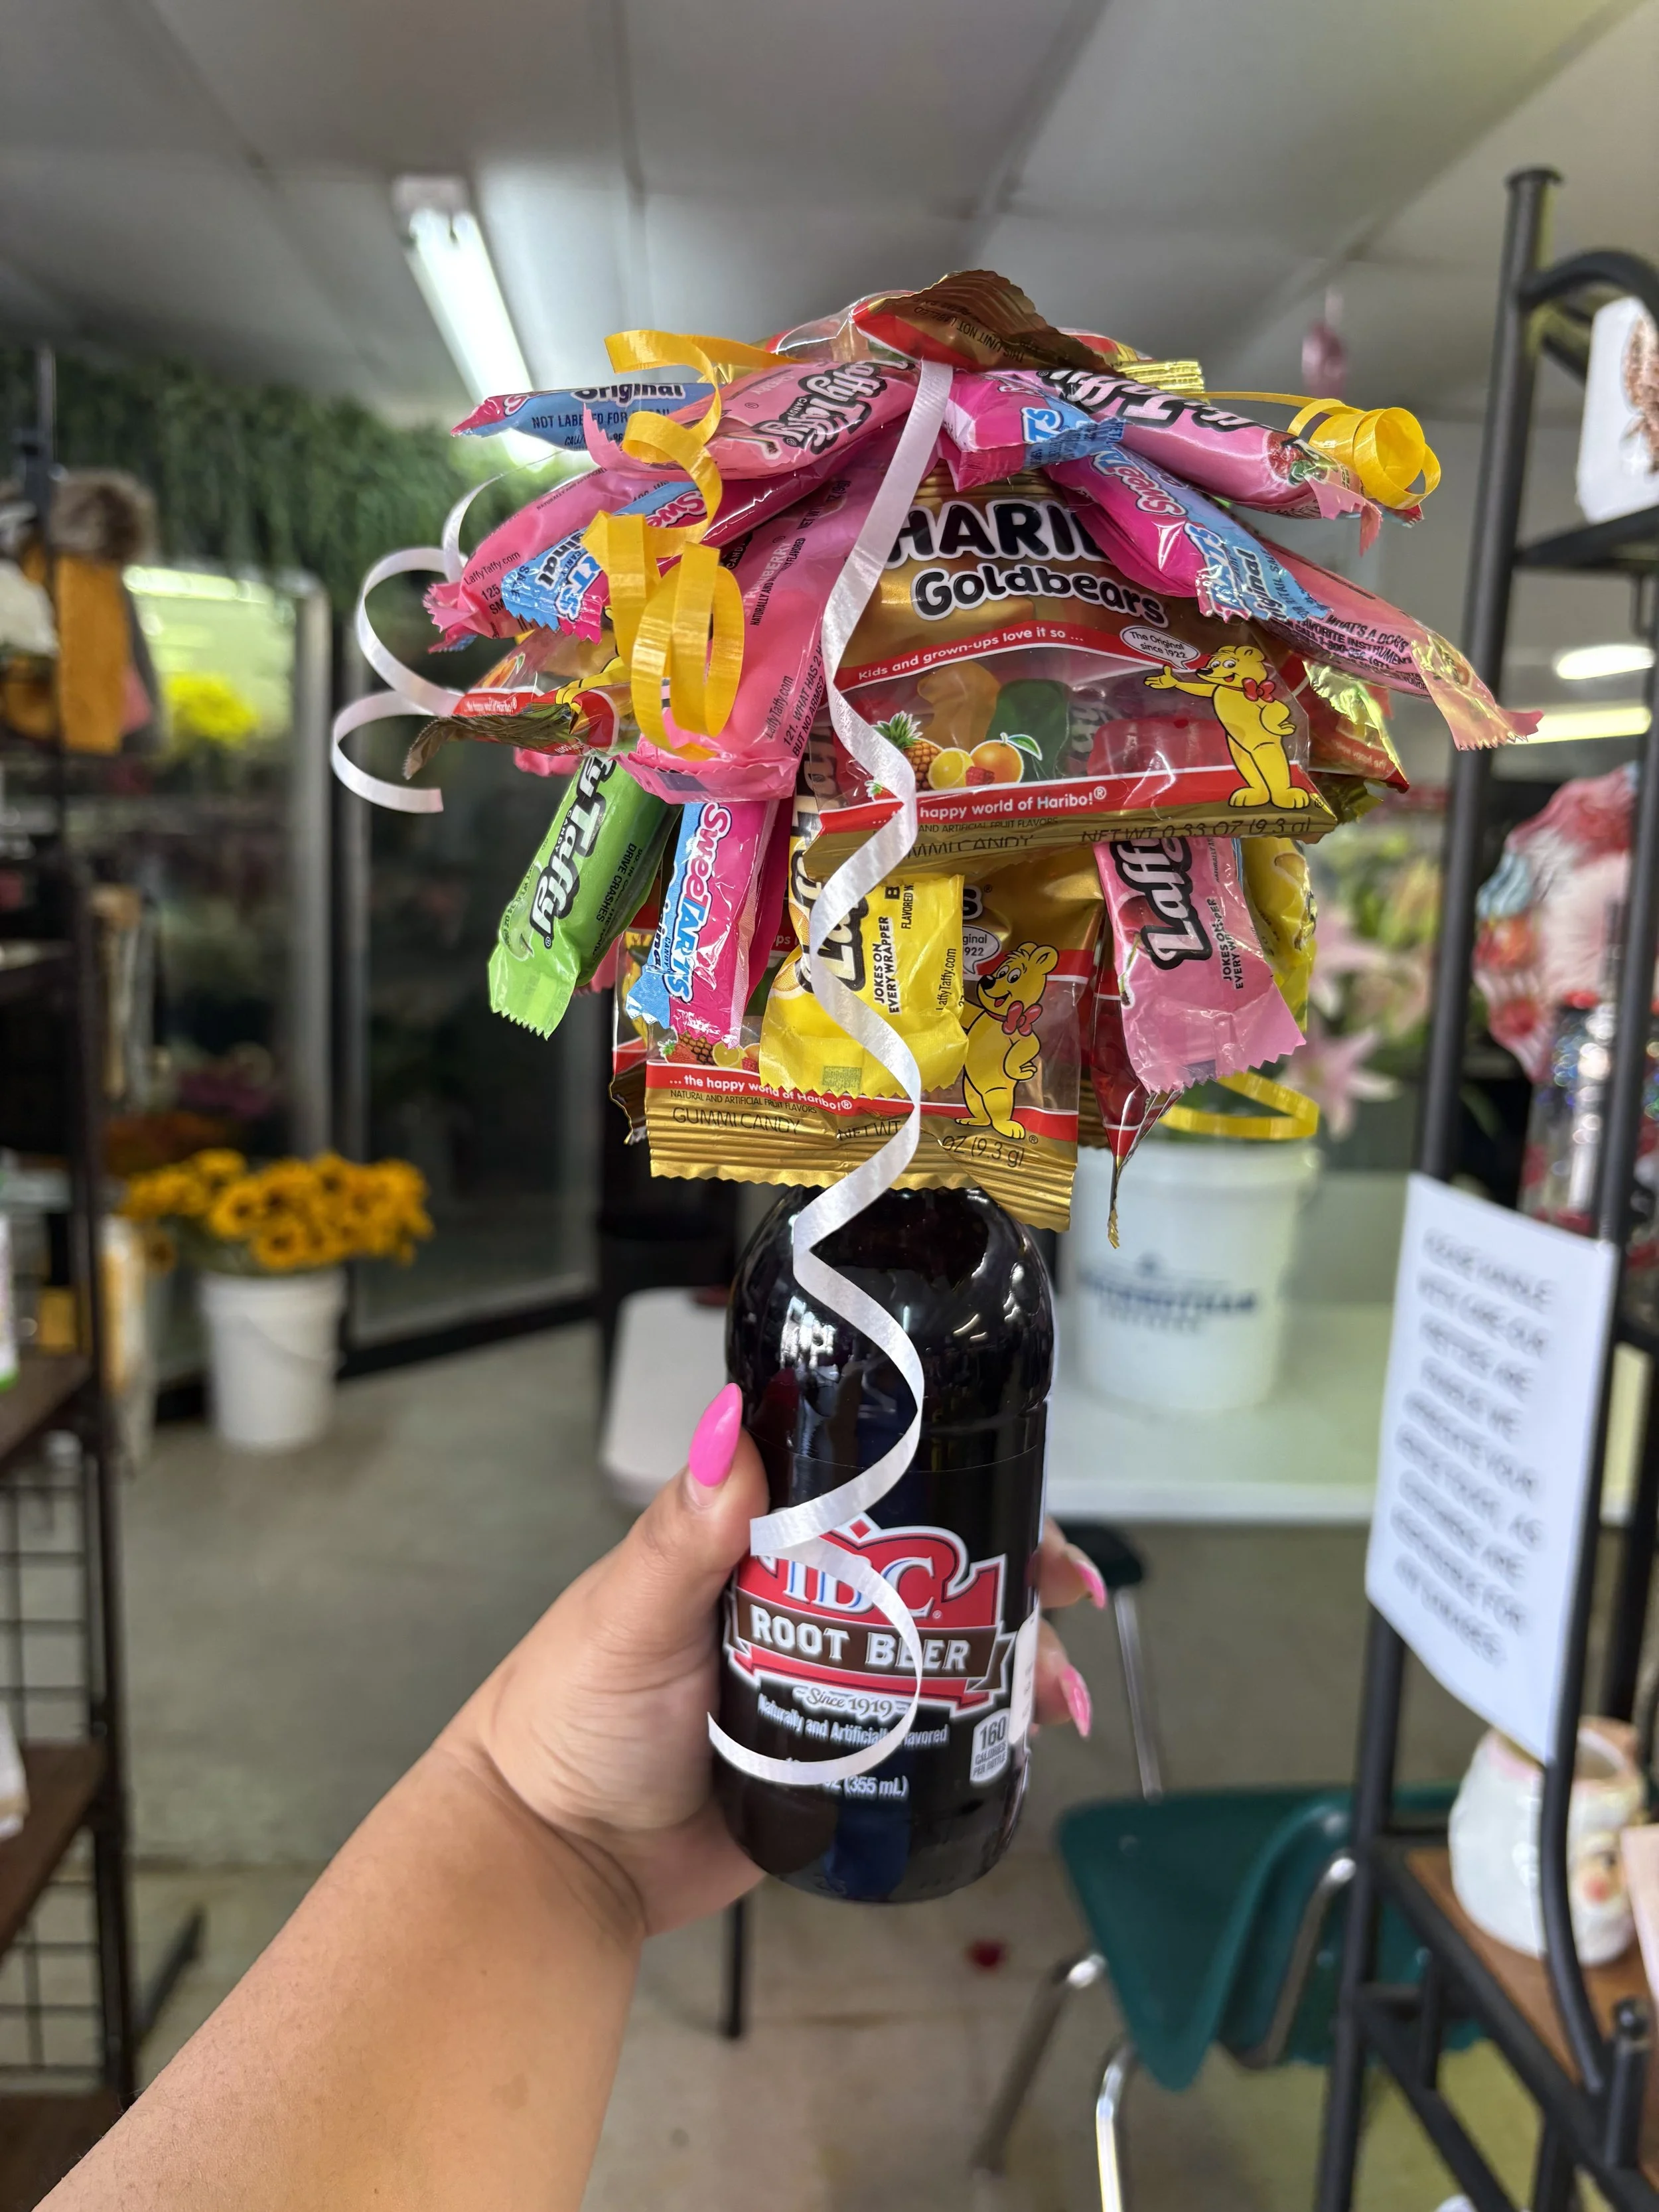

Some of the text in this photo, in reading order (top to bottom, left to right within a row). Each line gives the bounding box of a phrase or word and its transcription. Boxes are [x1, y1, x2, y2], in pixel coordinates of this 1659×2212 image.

[957, 321, 978, 340] NOT
[977, 334, 1003, 352] UNIT
[532, 416, 555, 429] NOT
[557, 411, 605, 427] LABEED
[607, 411, 628, 425] FOR
[887, 501, 1112, 563] HARI
[463, 551, 522, 586] LaffyTaffy.com
[786, 538, 806, 567] FLAVORED
[750, 593, 770, 626] NATURALLY
[912, 563, 1168, 627] Goldbears
[1129, 631, 1185, 650] The Original
[1327, 614, 1369, 638] WHAT'S
[859, 666, 889, 680] Kids
[892, 654, 920, 672] and
[923, 636, 999, 664] grown-ups
[1002, 627, 1033, 642] love
[1036, 626, 1046, 638] it
[1050, 628, 1066, 639] so
[1139, 642, 1188, 659] since 1922
[764, 675, 794, 739] LaffyTaffy.com
[784, 723, 799, 747] 121.
[792, 688, 811, 722] WHAT
[804, 664, 820, 691] HAS
[813, 656, 822, 667] 2
[792, 675, 826, 758] BUT NO ARMS?
[920, 806, 968, 821] happy
[972, 798, 1013, 816] world
[1017, 797, 1034, 812] of
[555, 809, 573, 852] CANDY
[918, 824, 940, 833] AND
[595, 842, 638, 923] DRIVE CRASHES
[901, 889, 914, 930] FLAVORED
[878, 915, 897, 974] WRAPPER
[963, 933, 988, 947] ginal
[964, 947, 985, 957] 922
[872, 942, 885, 1004] JOKES ON
[1216, 943, 1232, 982] JOKES
[1230, 949, 1244, 990] EVERY
[886, 975, 901, 1014] EVERY
[670, 1090, 818, 1114] NATURAL AND ARTIFICIAL FRUIT FLAVORS
[684, 1074, 704, 1088] the
[706, 1076, 745, 1093] happy
[748, 1082, 780, 1097] world
[782, 1090, 795, 1101] of
[672, 1106, 802, 1136] GUMMI CANDY
[873, 1120, 901, 1136] WT
[941, 1135, 966, 1154] OZ
[782, 1555, 936, 1620] IBC
[749, 1603, 972, 1672] ROOT BEER
[757, 1692, 805, 1734] Naturally
[805, 1718, 830, 1739] and
[902, 1724, 950, 1747] lavored
[806, 1686, 893, 1718] Since 1919
[979, 1716, 1007, 1751] 160
[843, 1775, 878, 1798] (355
[879, 1775, 910, 1800] mL)
